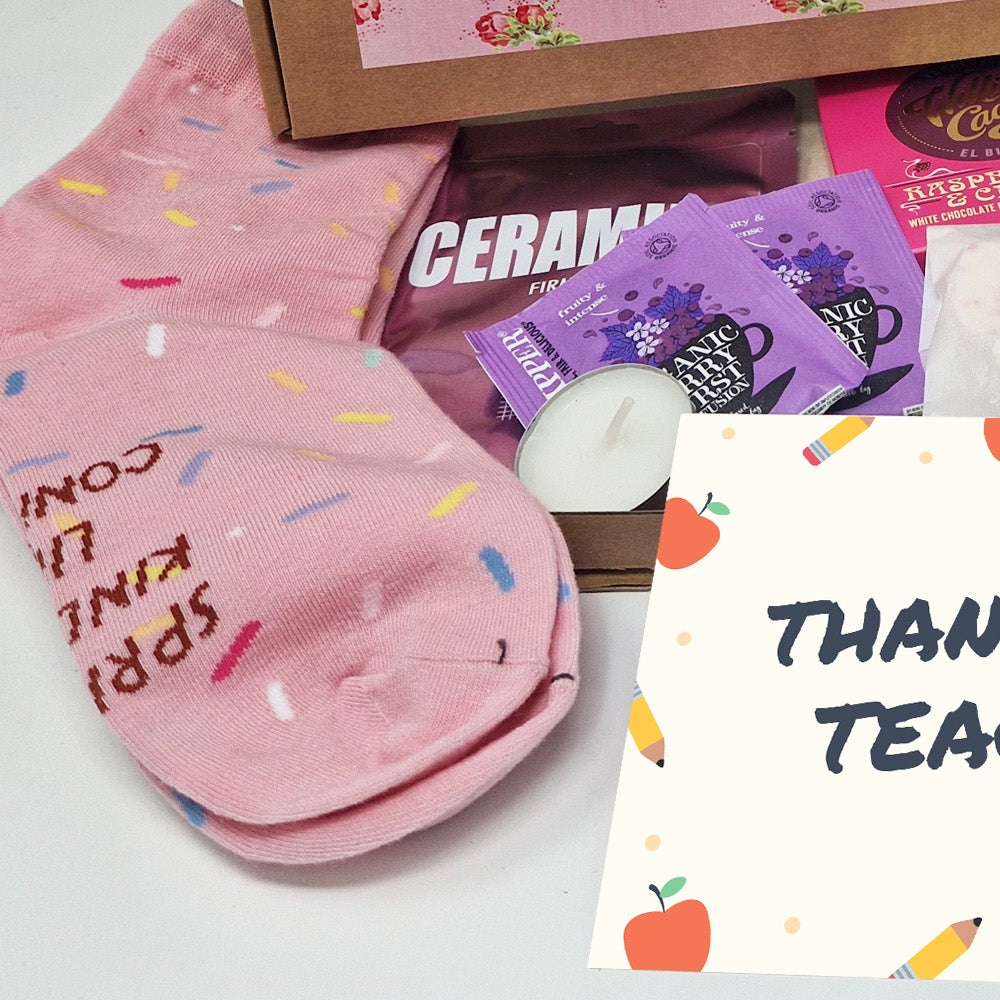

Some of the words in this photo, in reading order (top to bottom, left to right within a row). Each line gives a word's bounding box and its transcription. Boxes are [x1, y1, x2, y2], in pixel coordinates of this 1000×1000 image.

[960, 148, 978, 158] EL
[908, 213, 939, 228] WHITE
[941, 204, 996, 222] CHOCOLATE
[947, 192, 968, 208] &
[726, 217, 749, 228] uity
[755, 213, 766, 222] &
[735, 226, 764, 239] ense
[408, 203, 684, 288] CERAM
[558, 292, 592, 319] fruity
[594, 283, 607, 293] &
[565, 294, 609, 327] intense
[523, 321, 556, 357] DELICIOUS
[673, 324, 740, 378] ANIC
[555, 357, 573, 377] FAIR
[679, 344, 738, 397] RRY
[691, 360, 745, 409] RST
